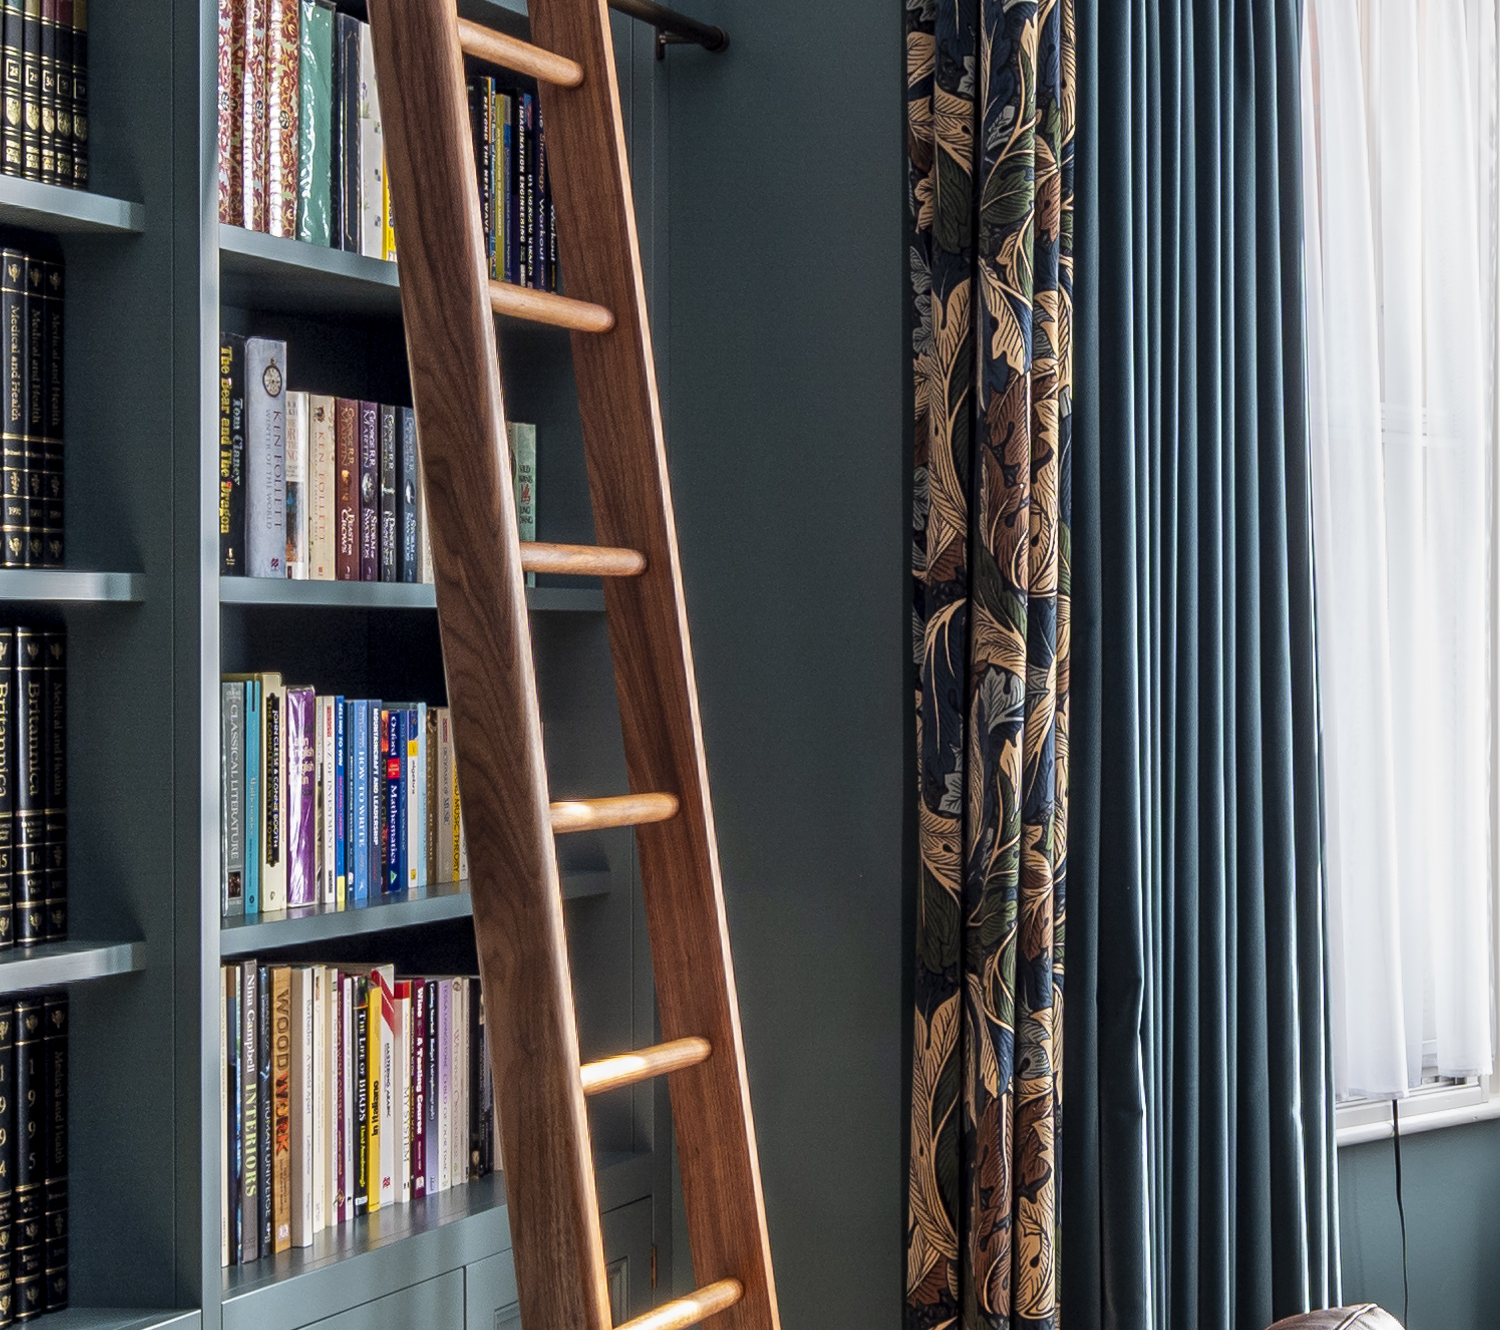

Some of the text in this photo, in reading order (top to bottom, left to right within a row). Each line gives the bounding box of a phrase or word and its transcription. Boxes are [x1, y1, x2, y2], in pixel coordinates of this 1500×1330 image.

[230, 704, 240, 859] CLASSICAL LITERATURE
[390, 785, 398, 864] Mathematics
[246, 974, 256, 1072] Nina Campbell
[246, 1084, 257, 1197] INTERIORS
